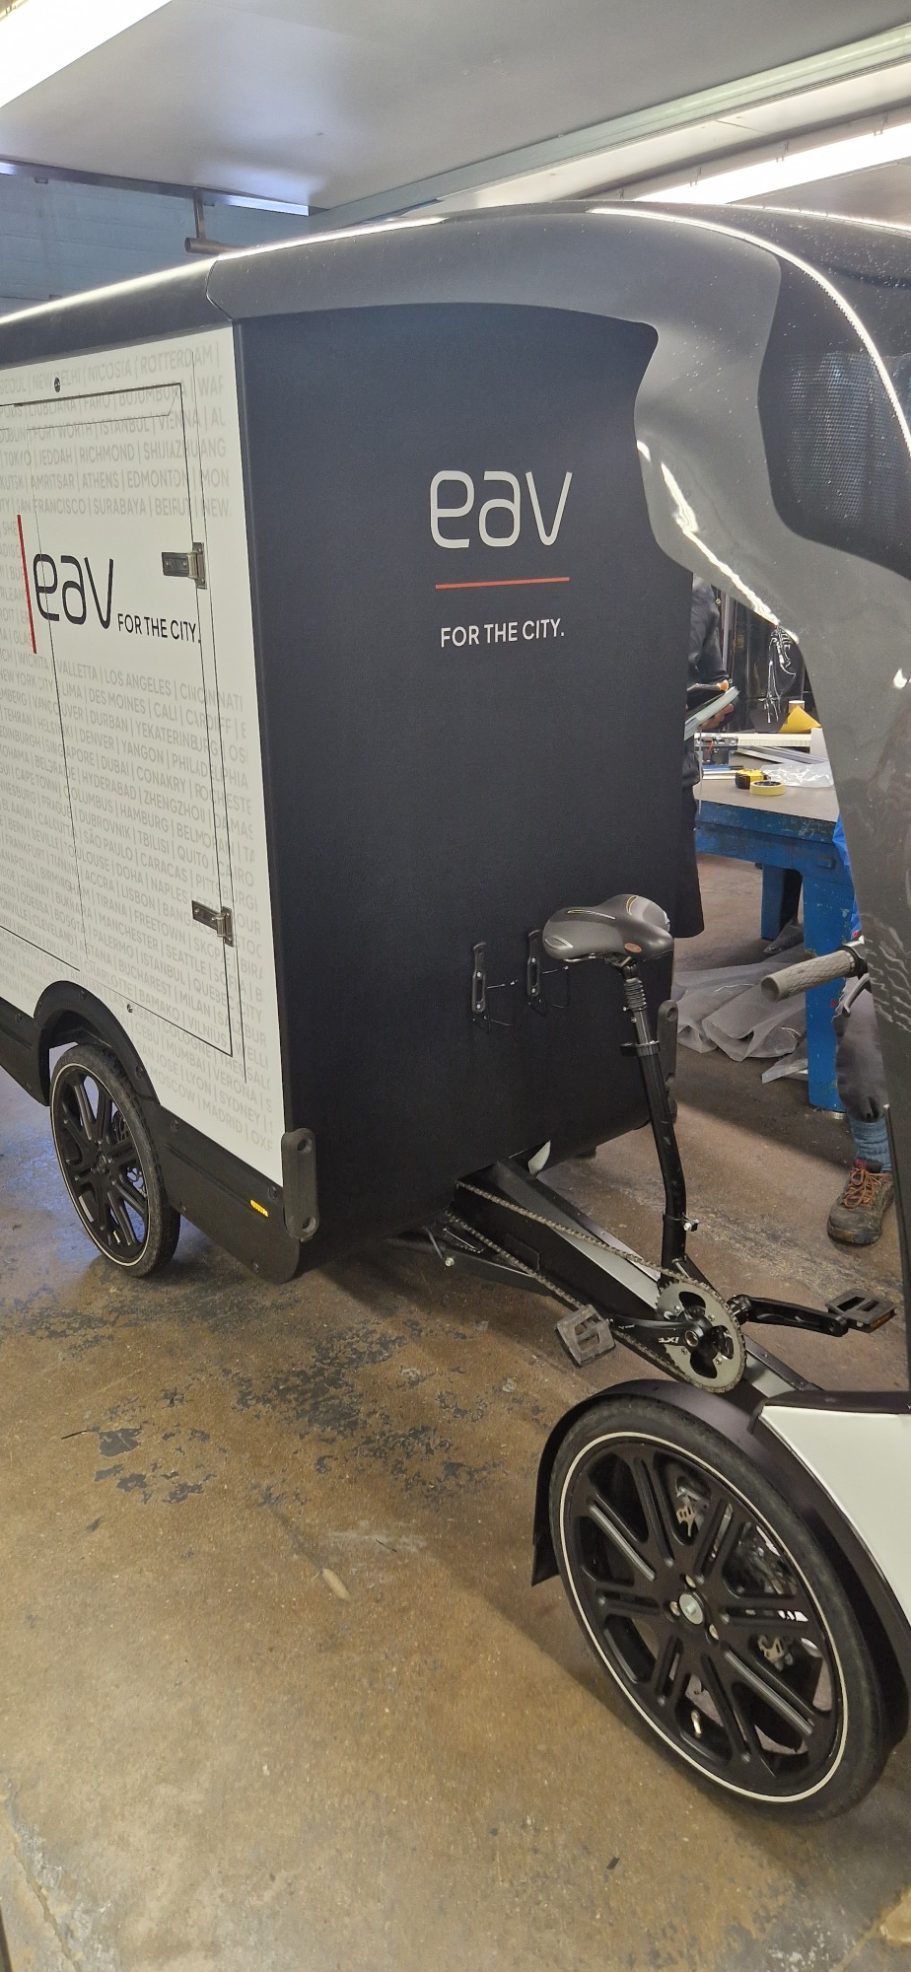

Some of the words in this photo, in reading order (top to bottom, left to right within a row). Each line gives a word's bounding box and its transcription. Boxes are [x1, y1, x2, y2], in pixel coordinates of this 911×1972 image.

[88, 359, 132, 382] NICOSIA
[141, 344, 213, 375] ROTTERDAM
[80, 443, 134, 465] RICHMOND
[144, 437, 226, 461] SHIJIAZHUANG
[82, 471, 120, 488] ATHENS
[127, 469, 188, 488] EDMONTON
[32, 498, 86, 514] FRANCISCO
[94, 497, 146, 515] SURABAYA
[430, 470, 572, 548] eav
[32, 553, 114, 630] eav
[117, 612, 142, 636] FOR
[144, 616, 168, 639] THE
[170, 620, 200, 644] CITY.
[441, 626, 479, 648] FOR
[484, 622, 518, 643] THE
[522, 618, 565, 640] CITY.
[57, 658, 98, 681] VALLETTA
[104, 668, 124, 686] LOS
[126, 673, 172, 697] ANGELES
[62, 682, 82, 700] LIMA
[89, 688, 107, 706] DES
[108, 692, 146, 714] MOINES
[154, 702, 177, 721] CALI
[186, 709, 231, 734] CARDIFF
[90, 710, 128, 732] DURBAN
[136, 720, 218, 756] YEKATERINBURG
[80, 728, 114, 750] DENVER
[122, 740, 164, 764] YANGON
[172, 753, 248, 789] PHILADELPHIA
[101, 756, 129, 777] DUBAI
[136, 766, 186, 794] CONAKRY
[82, 769, 136, 800] HYDERABAD
[144, 790, 206, 824] ZHENGZHOU
[120, 803, 168, 832] HAMBURG
[78, 808, 130, 839] DUBROVNIK
[138, 830, 169, 854] TBILISI
[177, 845, 208, 869] QUITO
[104, 838, 133, 861] PAULO
[140, 852, 188, 882] CARACAS
[85, 869, 114, 893] ACCRA
[122, 884, 156, 910] LISBON
[116, 862, 144, 886] DOHA
[150, 876, 188, 904] NAPLES
[96, 892, 126, 917] TIRANA
[134, 910, 186, 944] FREETOWN
[98, 912, 159, 952] MANCHESTER
[166, 944, 206, 975] SEATTLE
[118, 958, 170, 997] BUCHAREST
[180, 990, 210, 1018] MILAN
[140, 951, 186, 986] ISTANBUL
[188, 1014, 227, 1048] VILNIUS
[203, 1098, 243, 1134] MADRID
